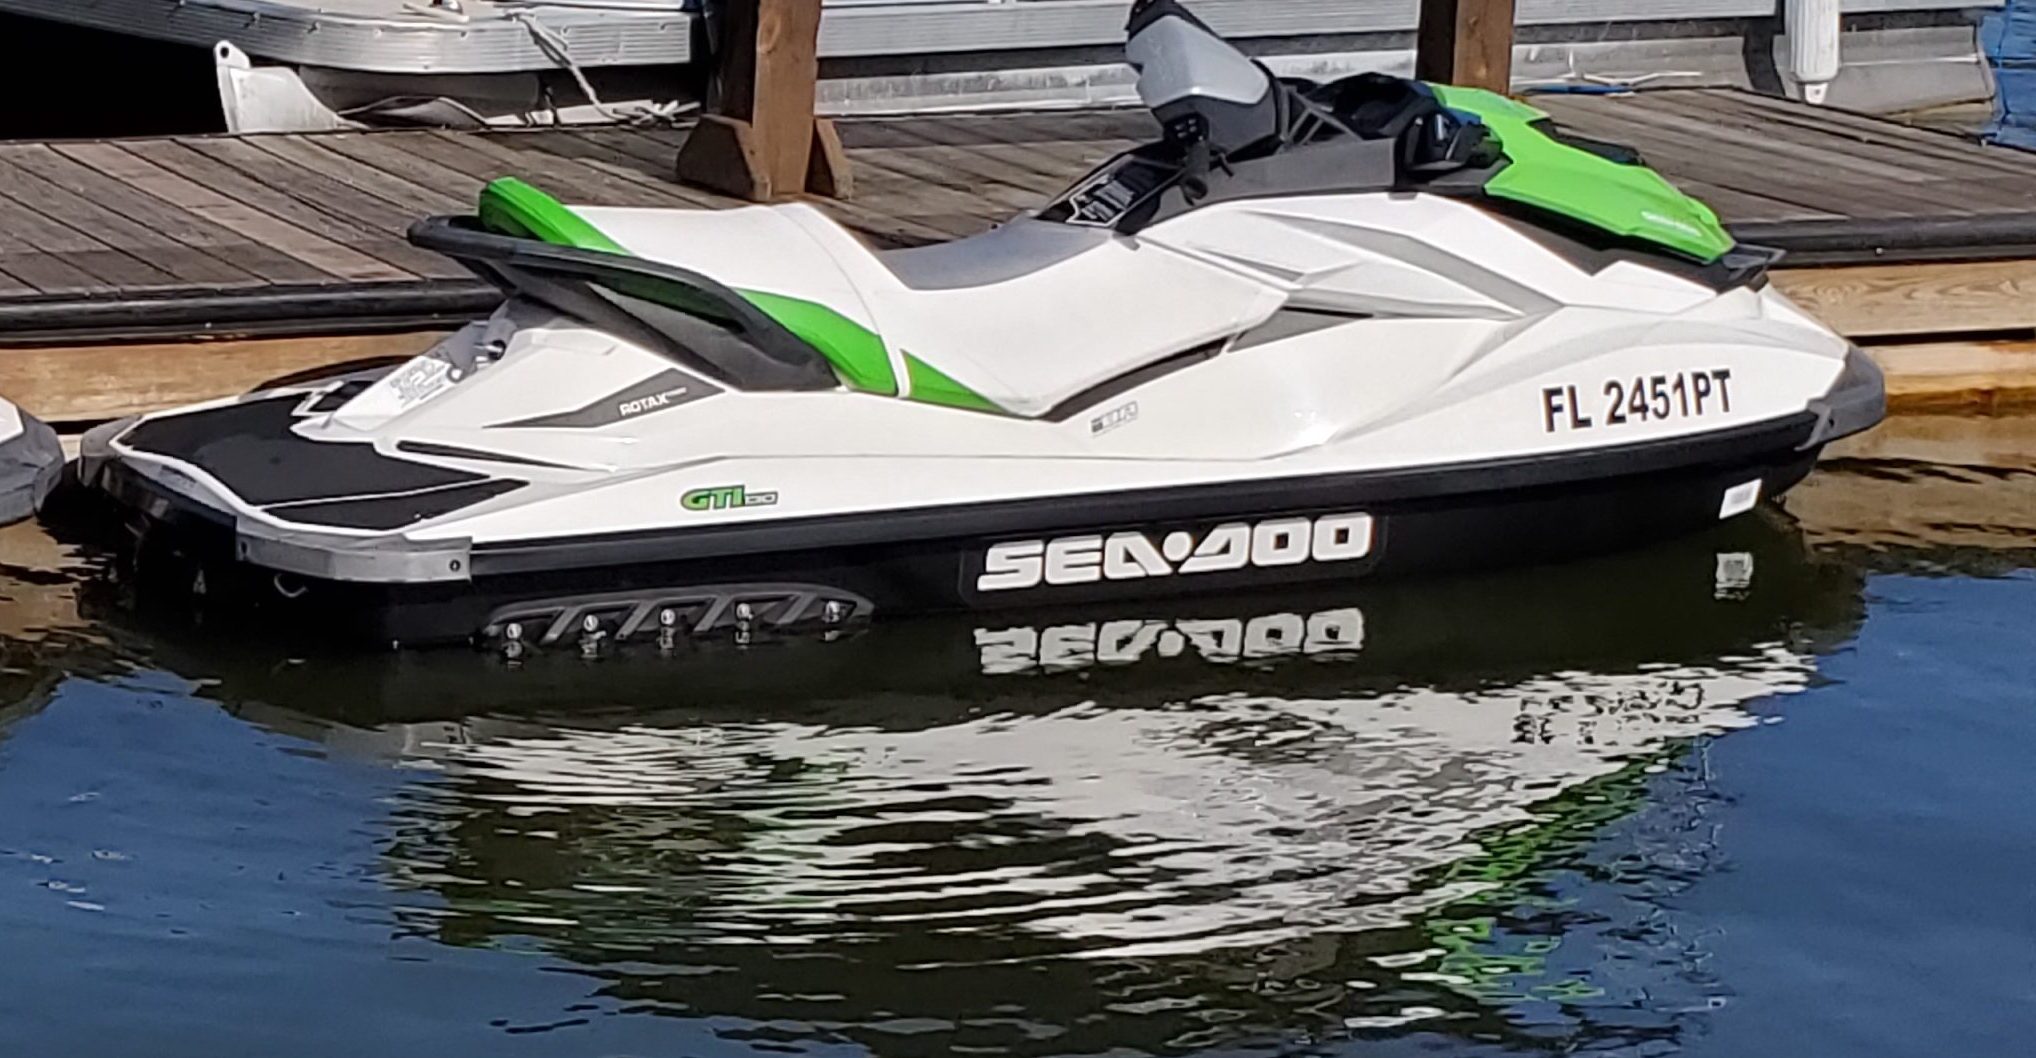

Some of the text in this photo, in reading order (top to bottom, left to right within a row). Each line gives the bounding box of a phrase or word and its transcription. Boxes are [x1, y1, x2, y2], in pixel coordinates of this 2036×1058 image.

[619, 392, 670, 416] ROTAX
[1542, 368, 1731, 433] FL 2451PT
[680, 484, 745, 511] GTI
